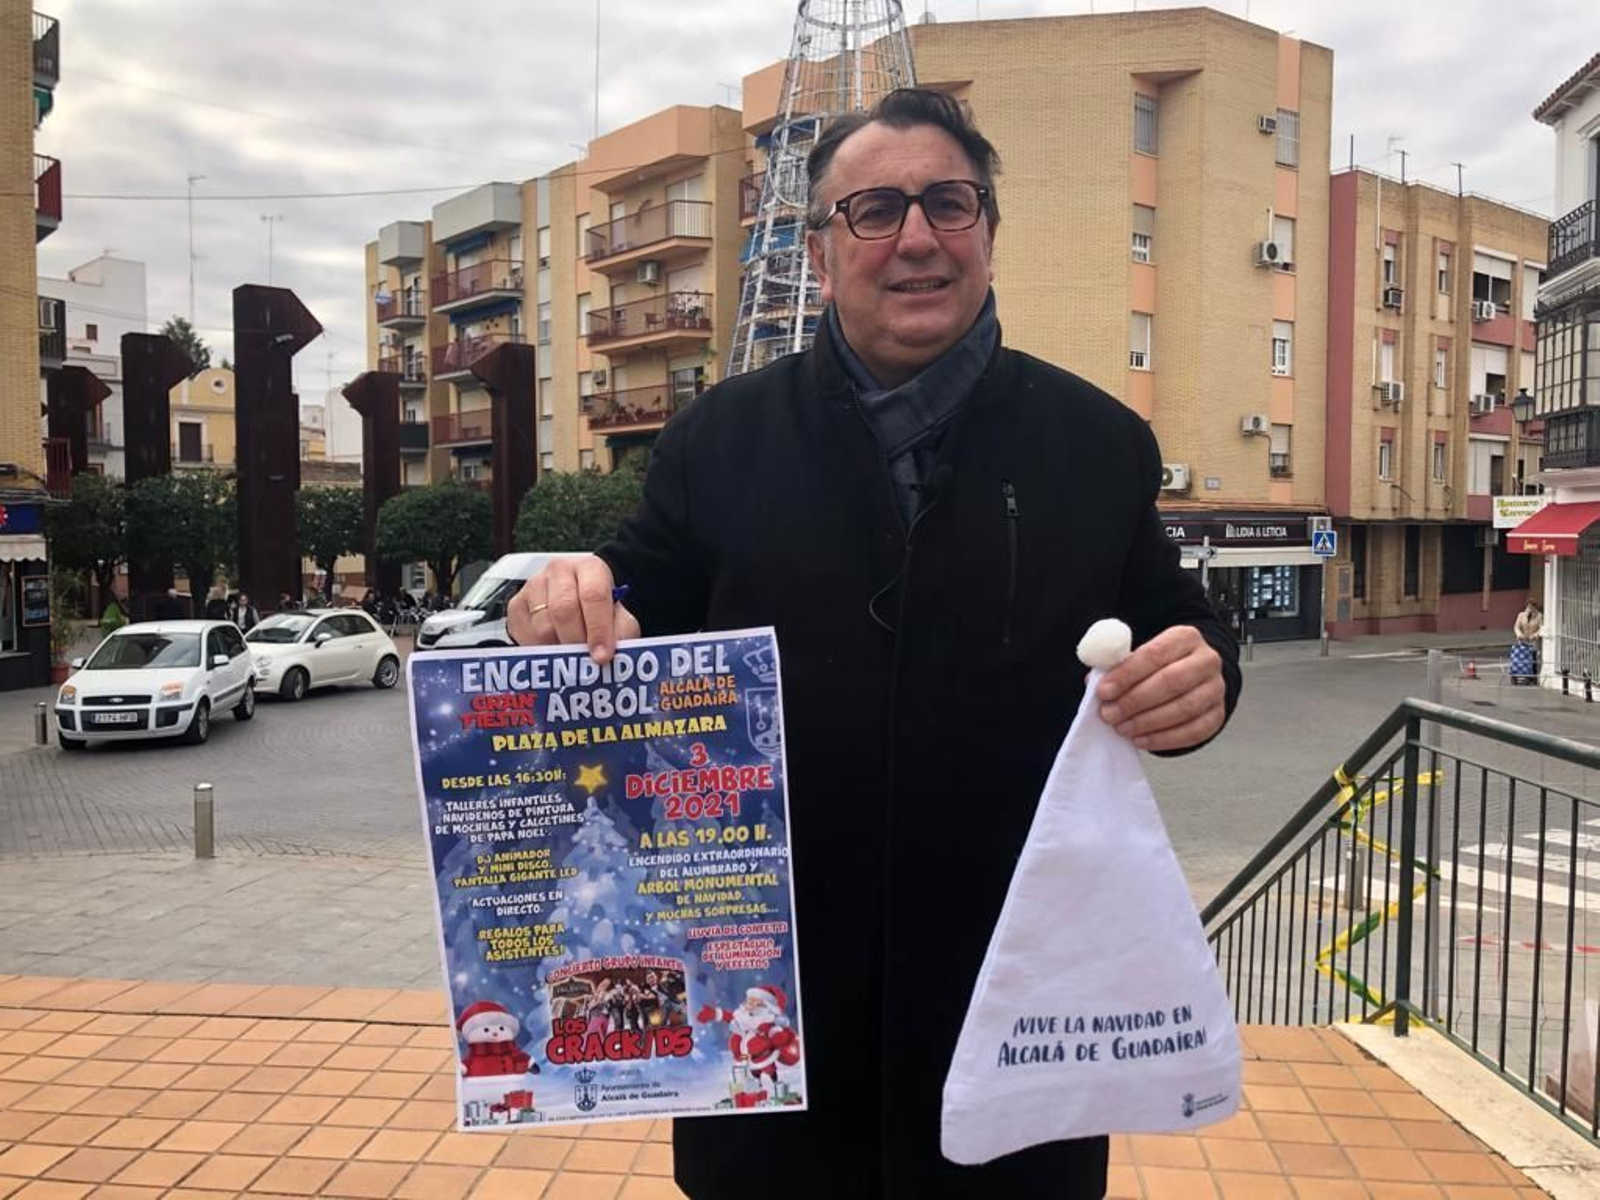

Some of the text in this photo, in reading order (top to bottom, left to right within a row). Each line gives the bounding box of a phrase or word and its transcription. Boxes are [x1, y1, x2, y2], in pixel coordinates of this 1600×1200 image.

[461, 645, 730, 692] ENCENDIDO DEL
[716, 676, 737, 689] DE
[471, 693, 537, 710] GRAN
[546, 686, 654, 722] ÁRBOL
[461, 711, 536, 729] FIESTA
[492, 715, 728, 751] PLAZA DE LA ALMAZARA
[689, 743, 709, 766] 3
[442, 777, 484, 789] DESDE
[488, 775, 512, 786] LAS
[445, 794, 563, 811] TALLERES INFANTILES
[508, 809, 522, 818] DE
[525, 804, 575, 816] PINTURA
[664, 793, 741, 819] 2021
[435, 815, 585, 835] DE MOCHILAS Y CALCETINES
[470, 833, 484, 842] DE
[639, 832, 653, 848] A
[656, 830, 690, 846] LAS
[694, 825, 750, 844] 19.00
[494, 850, 551, 861] ANIMADOR
[628, 847, 789, 867] ENCENDIDO EXTRAORDINARIO
[454, 876, 507, 887] PANTALLA
[509, 870, 557, 882] GIGANTE
[477, 865, 486, 875] Y
[659, 863, 759, 878] DEL ALUMBRADO Y
[684, 874, 779, 891] MONUMENTAL
[472, 891, 564, 907] ACTUACIONES EN
[676, 894, 691, 905] DE
[645, 913, 655, 923] Y
[657, 909, 702, 921] MUCHAS
[478, 924, 565, 939] REGALOS PARA
[490, 936, 554, 949] TODOS LOS
[546, 960, 602, 984] CONCIERTO
[602, 955, 637, 969] GRUPO
[552, 1017, 588, 1035] LOS
[1064, 1015, 1086, 1034] LA
[1092, 1008, 1166, 1034] NAVIDAD
[1173, 1004, 1193, 1024] EN
[1075, 1042, 1100, 1062] DE
[628, 1092, 640, 1100] de
